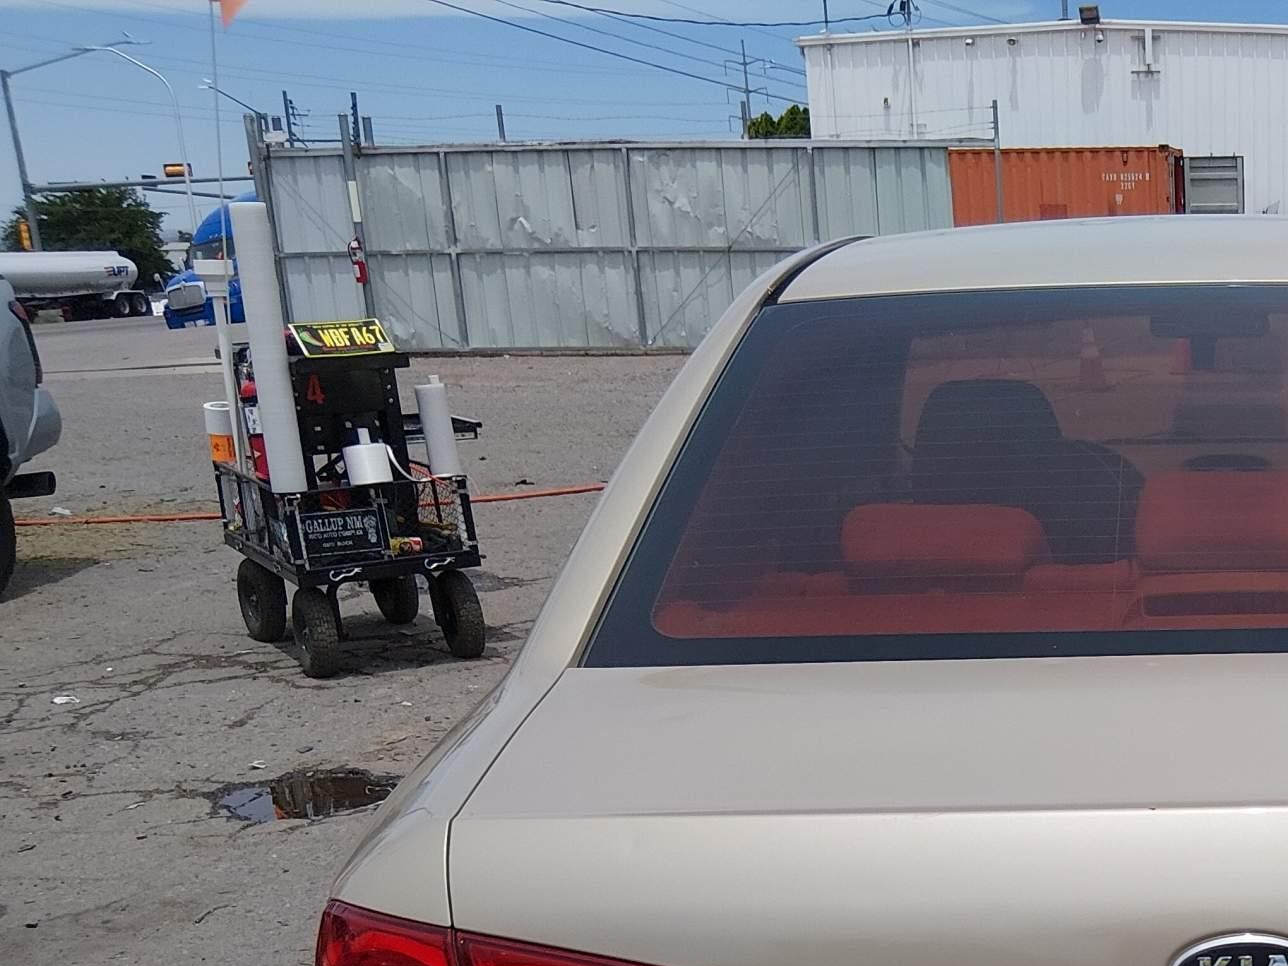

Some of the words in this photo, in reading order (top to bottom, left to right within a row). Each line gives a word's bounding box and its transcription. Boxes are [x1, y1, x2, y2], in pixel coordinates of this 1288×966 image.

[350, 325, 384, 346] A67
[306, 373, 326, 404] 4
[305, 518, 343, 533] GALLUP
[345, 515, 363, 529] NM
